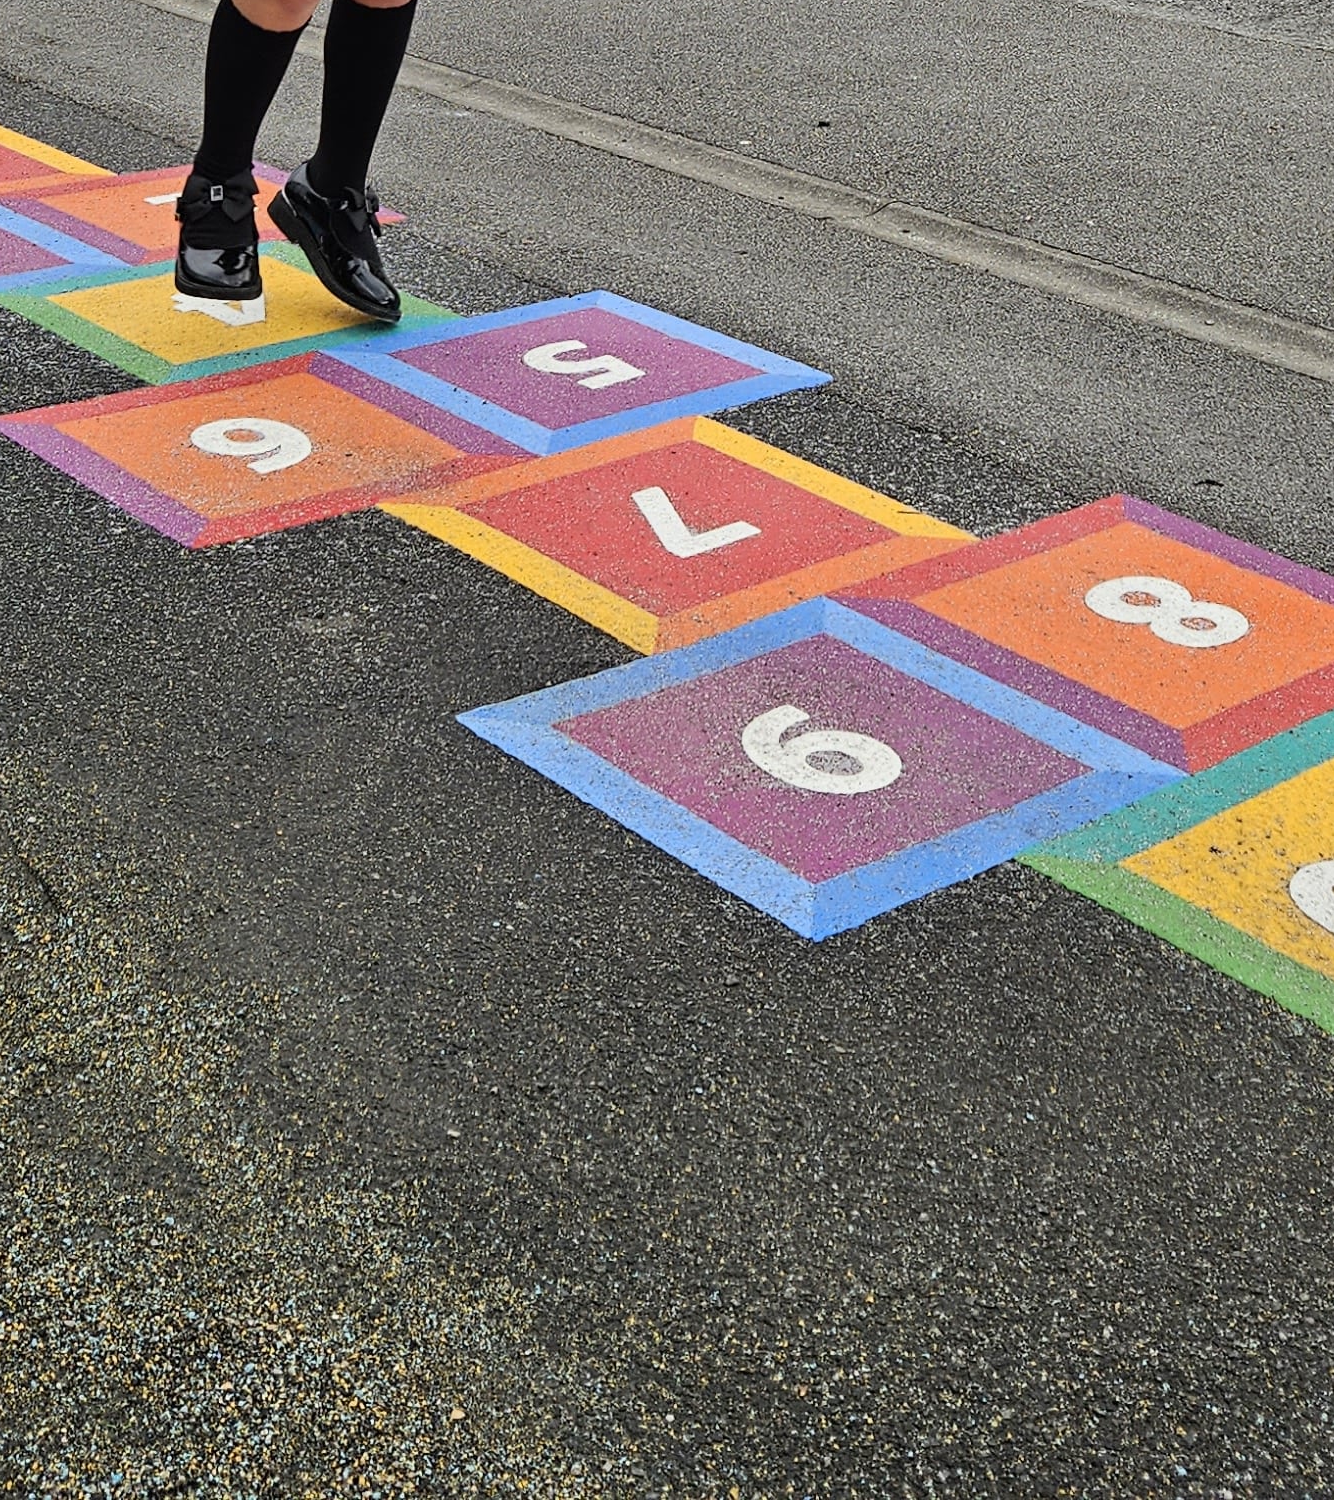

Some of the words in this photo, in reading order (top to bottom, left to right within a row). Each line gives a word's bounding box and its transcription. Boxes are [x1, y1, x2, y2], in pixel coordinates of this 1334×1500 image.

[521, 339, 648, 390] 5
[189, 417, 315, 476] 6
[630, 485, 762, 560] 7
[1083, 575, 1251, 649] 8
[740, 703, 904, 795] 9
